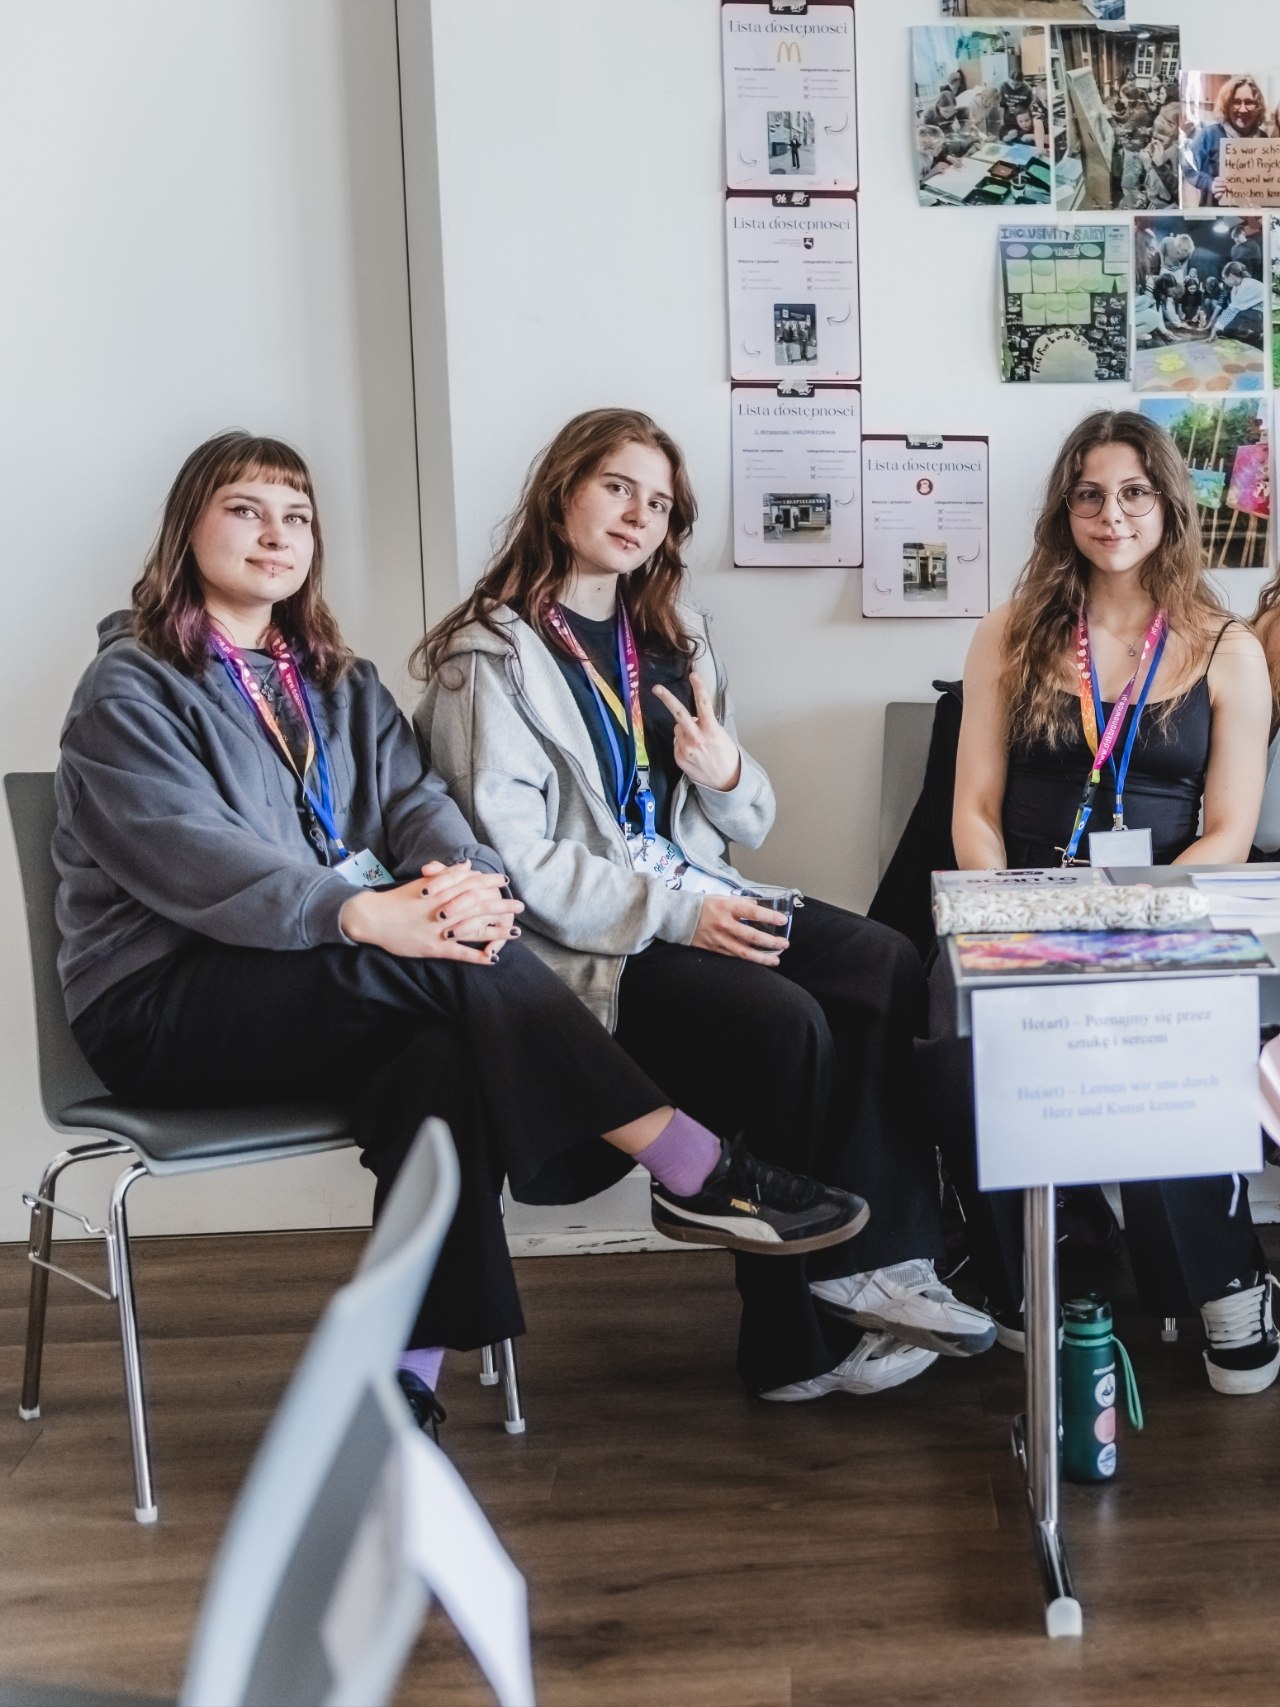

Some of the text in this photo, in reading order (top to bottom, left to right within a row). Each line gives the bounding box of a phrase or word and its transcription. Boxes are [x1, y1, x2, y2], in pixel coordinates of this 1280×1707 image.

[729, 20, 761, 33] Lista
[1225, 143, 1237, 155] Es
[1246, 174, 1259, 183] weil
[732, 216, 766, 230] Lista
[738, 403, 770, 417] Lista
[867, 459, 899, 472] Lista
